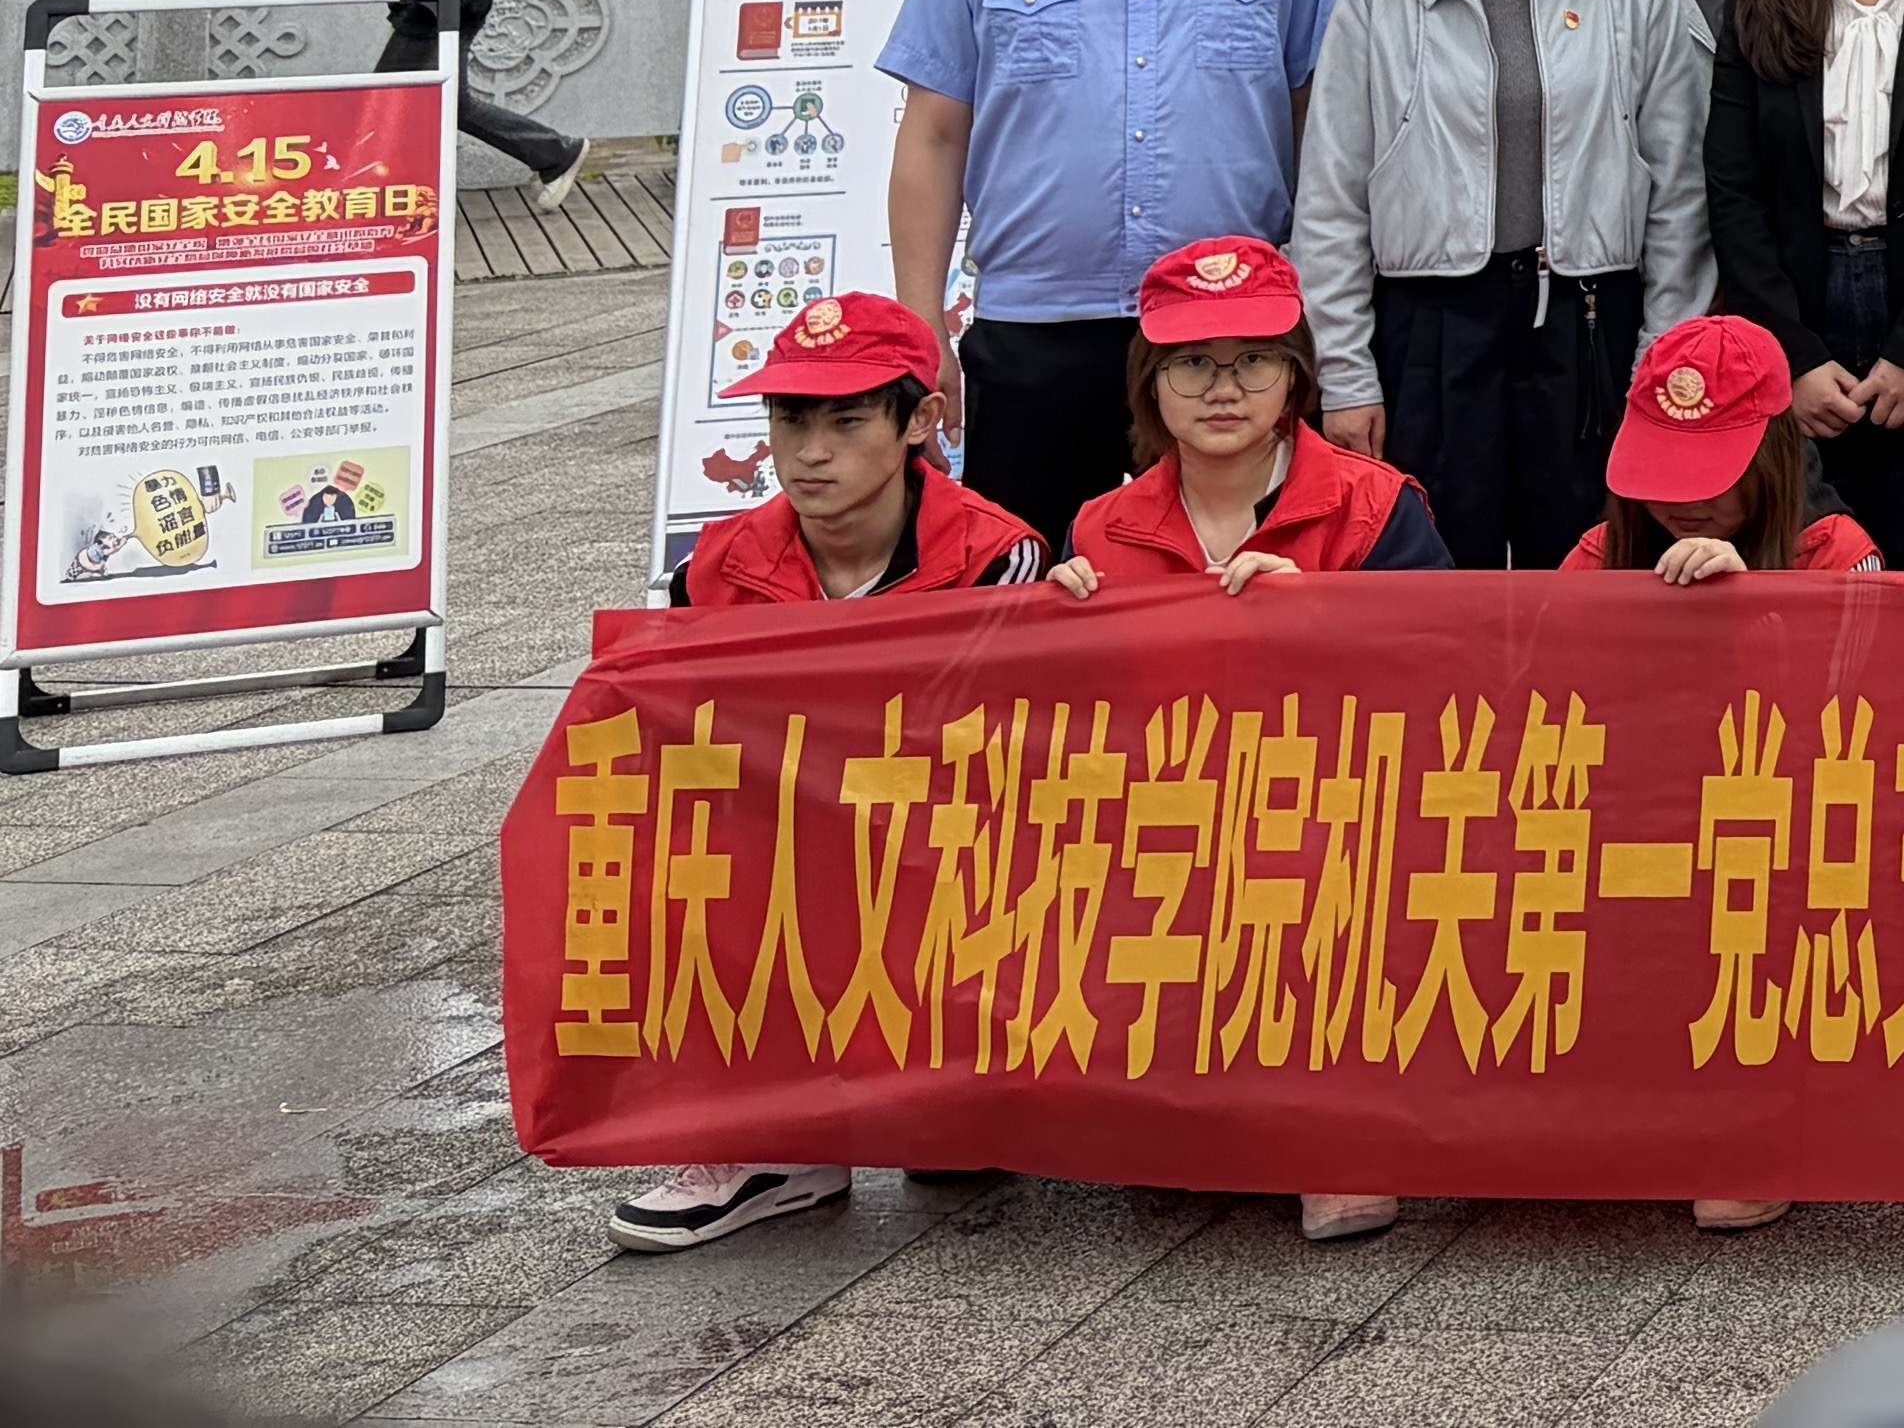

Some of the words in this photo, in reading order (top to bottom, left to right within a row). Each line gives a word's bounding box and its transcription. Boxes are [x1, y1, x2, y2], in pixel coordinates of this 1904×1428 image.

[175, 134, 313, 185] 4.15
[56, 183, 421, 238] 全民国家安全教育日
[133, 277, 371, 311] 没有网络安全就没有国家安全
[149, 487, 189, 513] 色情
